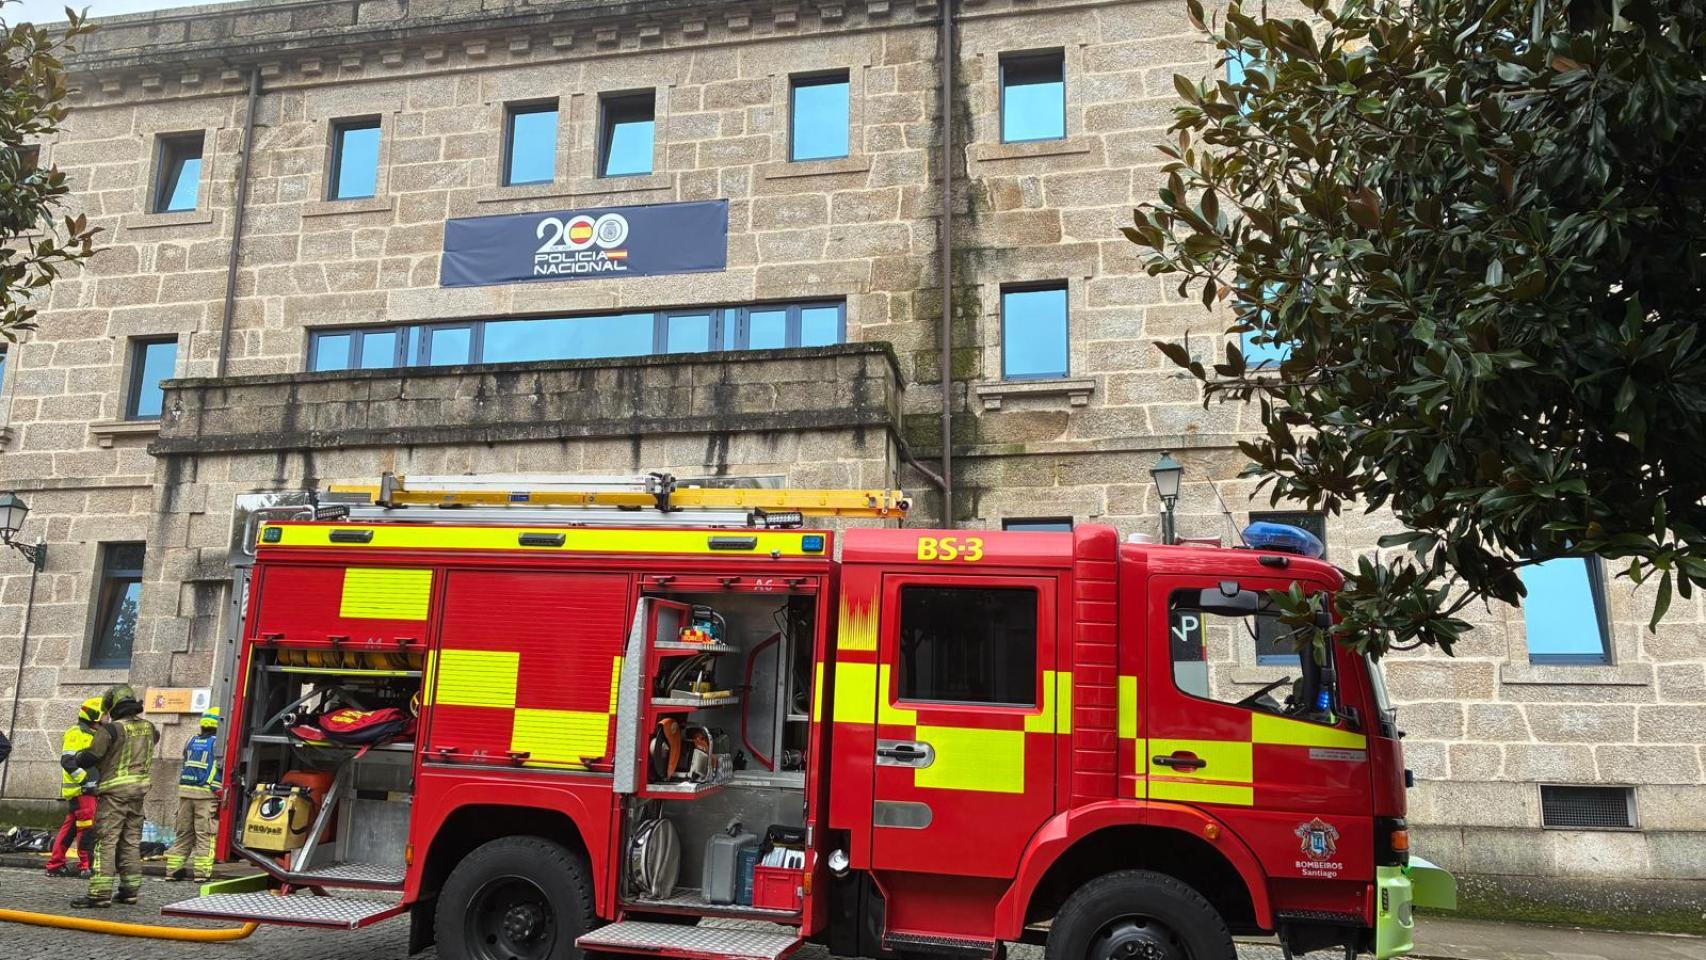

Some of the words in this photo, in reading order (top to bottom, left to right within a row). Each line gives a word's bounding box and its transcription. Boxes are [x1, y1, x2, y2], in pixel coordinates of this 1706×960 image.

[536, 212, 629, 253] 200
[534, 250, 609, 264] POLICIA
[533, 260, 628, 275] NACIONAL
[917, 536, 984, 561] BS-3
[1295, 860, 1344, 870] BOMBEIROS
[1302, 869, 1338, 879] Santiago
